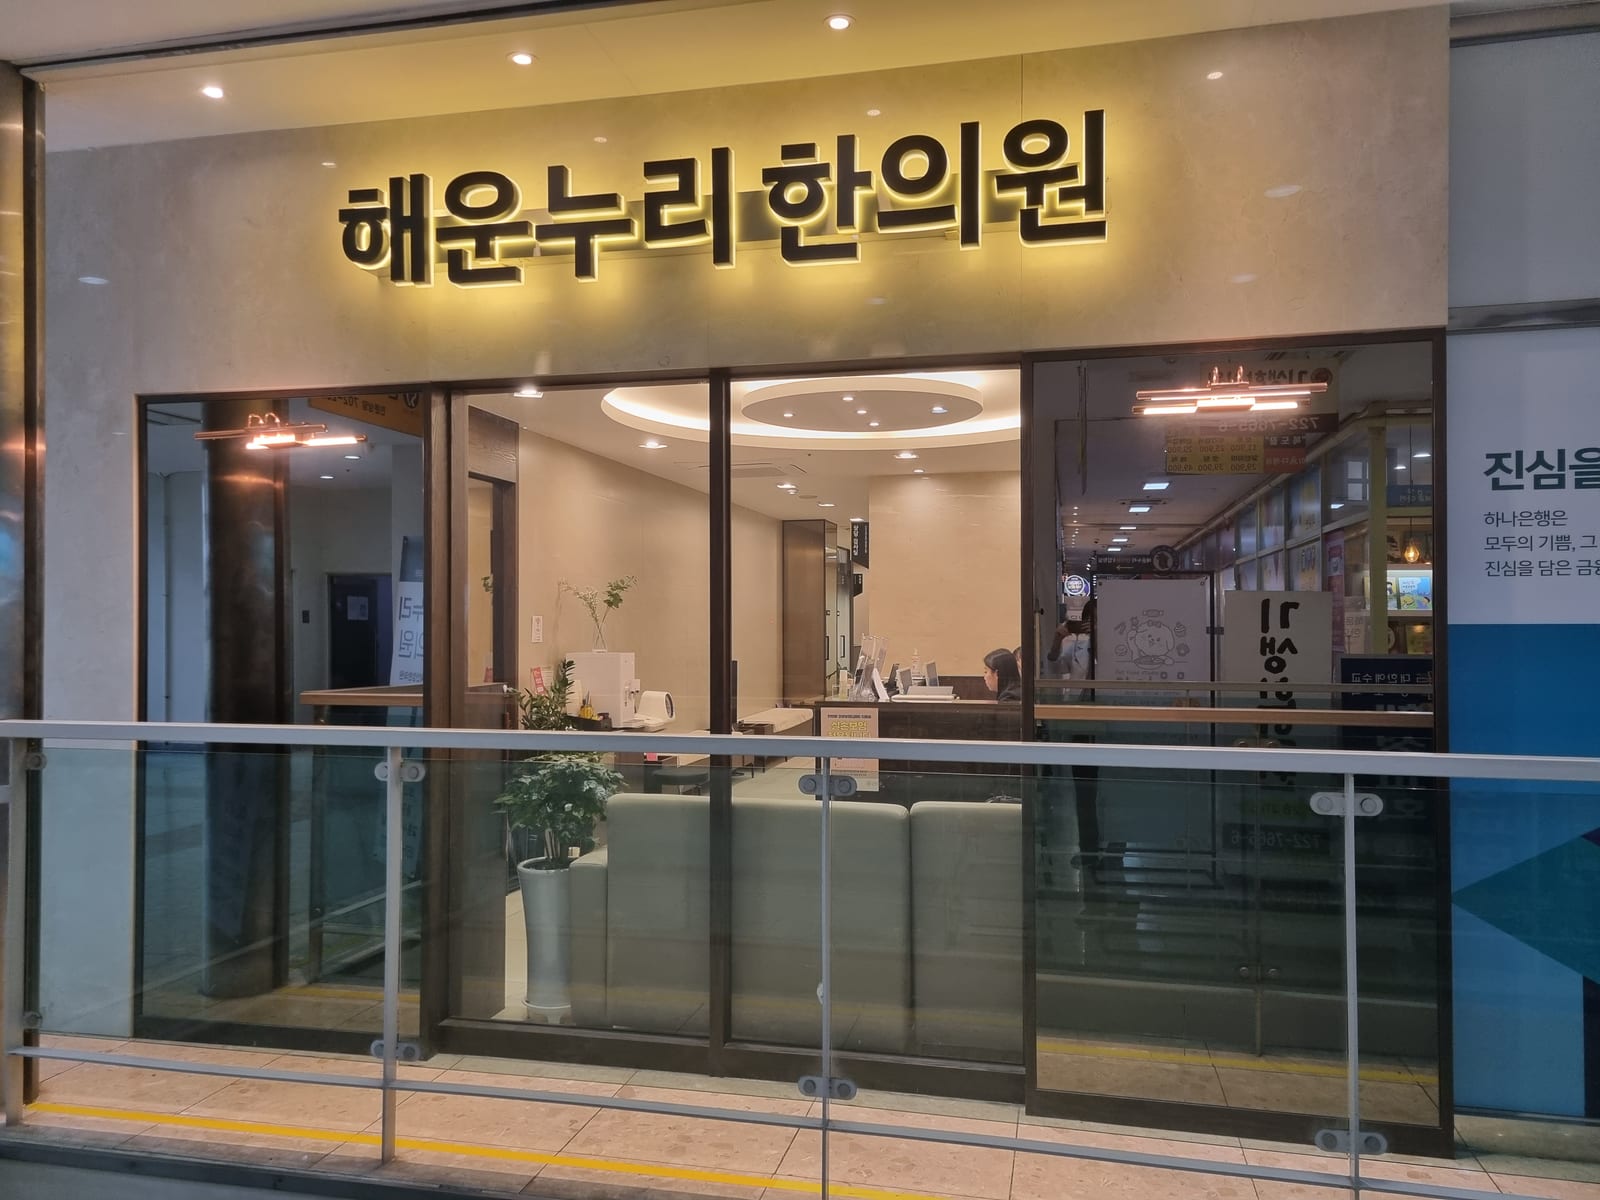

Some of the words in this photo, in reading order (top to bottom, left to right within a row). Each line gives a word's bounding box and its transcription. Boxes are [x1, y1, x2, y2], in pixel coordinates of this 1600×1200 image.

[338, 146, 736, 286] 해운누리
[761, 109, 1107, 264] 한의원
[1483, 447, 1600, 491] 진심을
[1483, 510, 1568, 528] 하나은행은
[1484, 535, 1533, 552] 모두의
[1580, 535, 1598, 549] 그
[1484, 560, 1534, 577] 진심을
[1538, 560, 1572, 577] 담은
